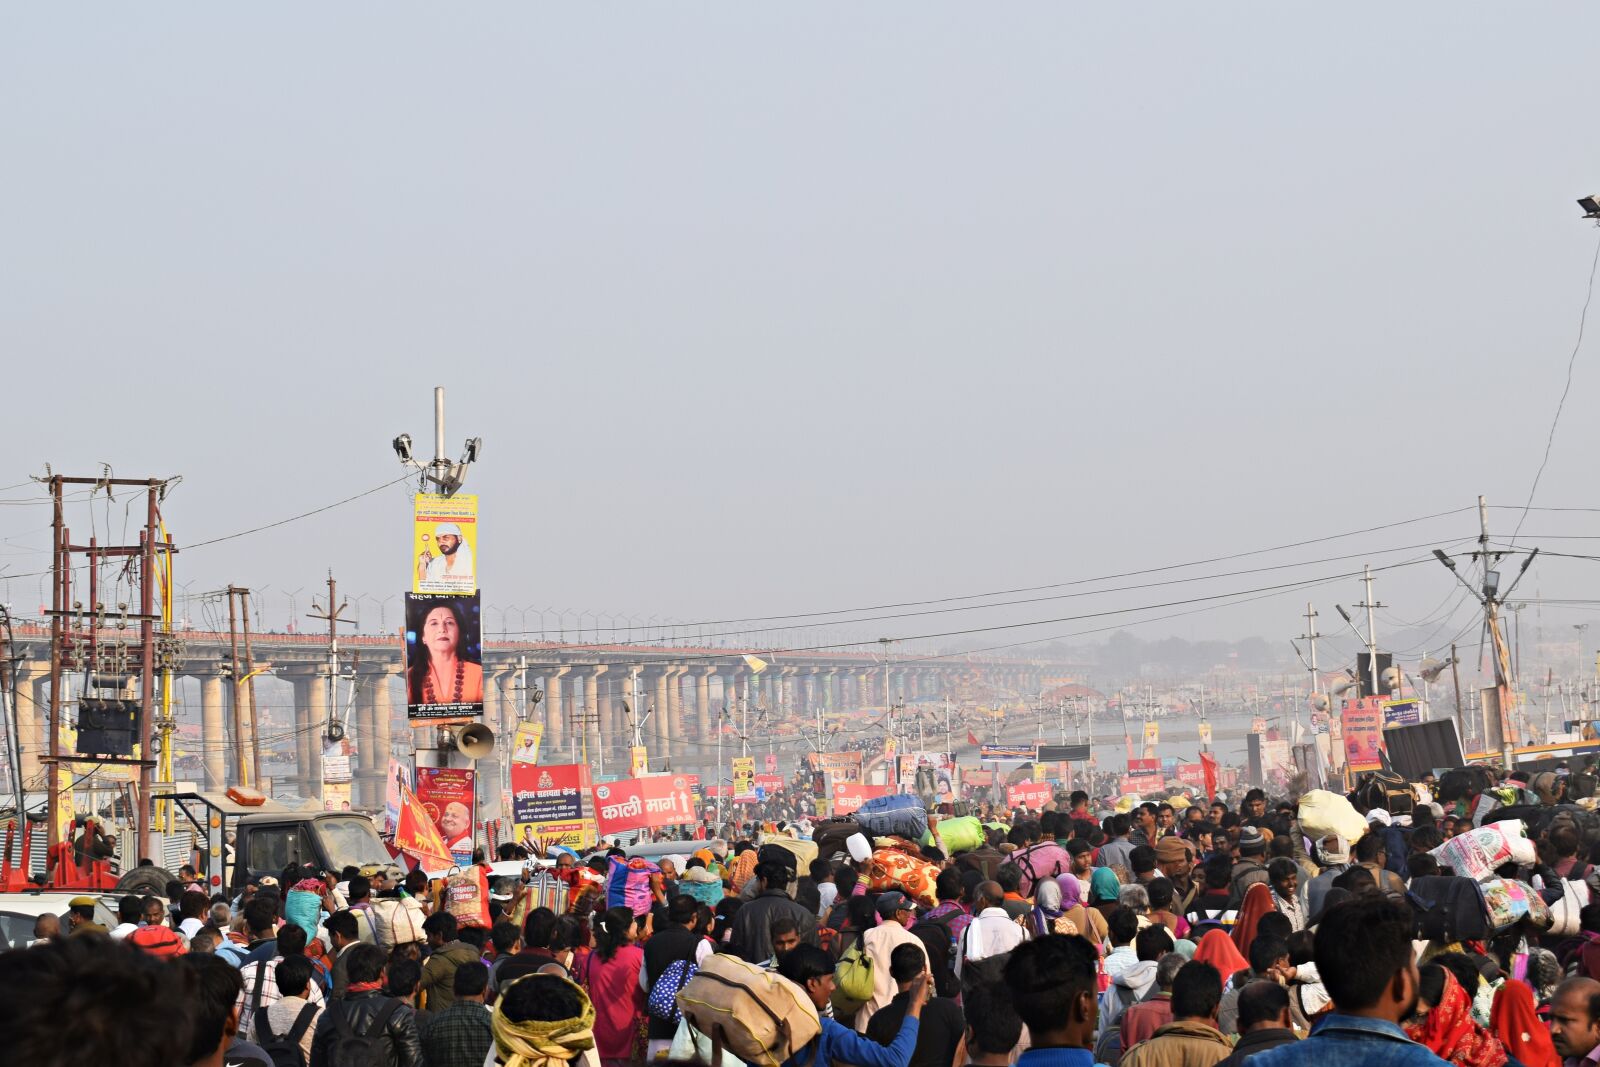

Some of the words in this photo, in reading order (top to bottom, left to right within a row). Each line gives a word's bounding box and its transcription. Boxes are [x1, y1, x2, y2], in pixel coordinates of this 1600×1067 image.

[516, 790, 535, 801] पुलिस
[537, 789, 560, 798] सहायता
[563, 787, 576, 795] केन्द्र
[1038, 791, 1049, 803] पुल
[601, 795, 642, 820] काली
[645, 792, 676, 812] मार्ग
[838, 795, 862, 808] काली
[451, 885, 476, 893] Sangeeta
